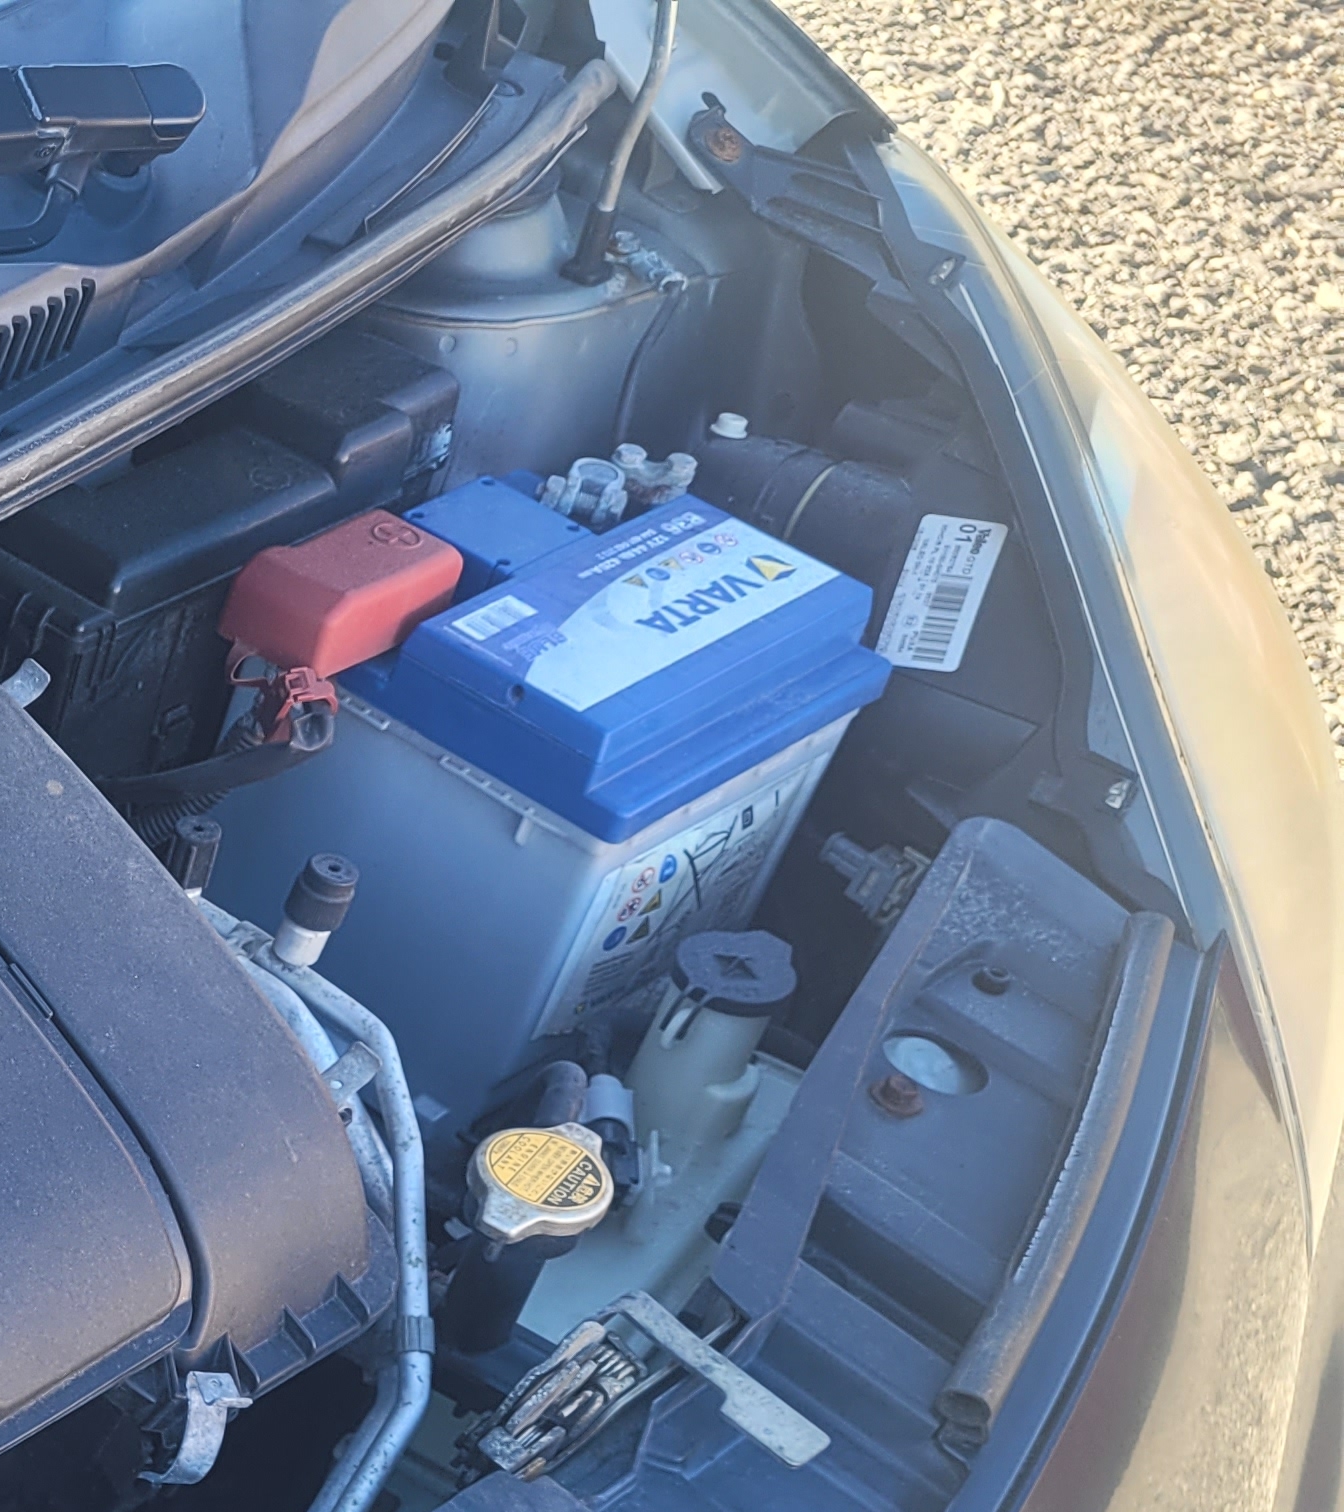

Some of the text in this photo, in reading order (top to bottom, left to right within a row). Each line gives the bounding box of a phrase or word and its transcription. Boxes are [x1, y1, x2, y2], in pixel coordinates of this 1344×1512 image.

[954, 523, 977, 544] 01
[634, 575, 764, 634] VARTA
[547, 1161, 592, 1205] CAUTION
